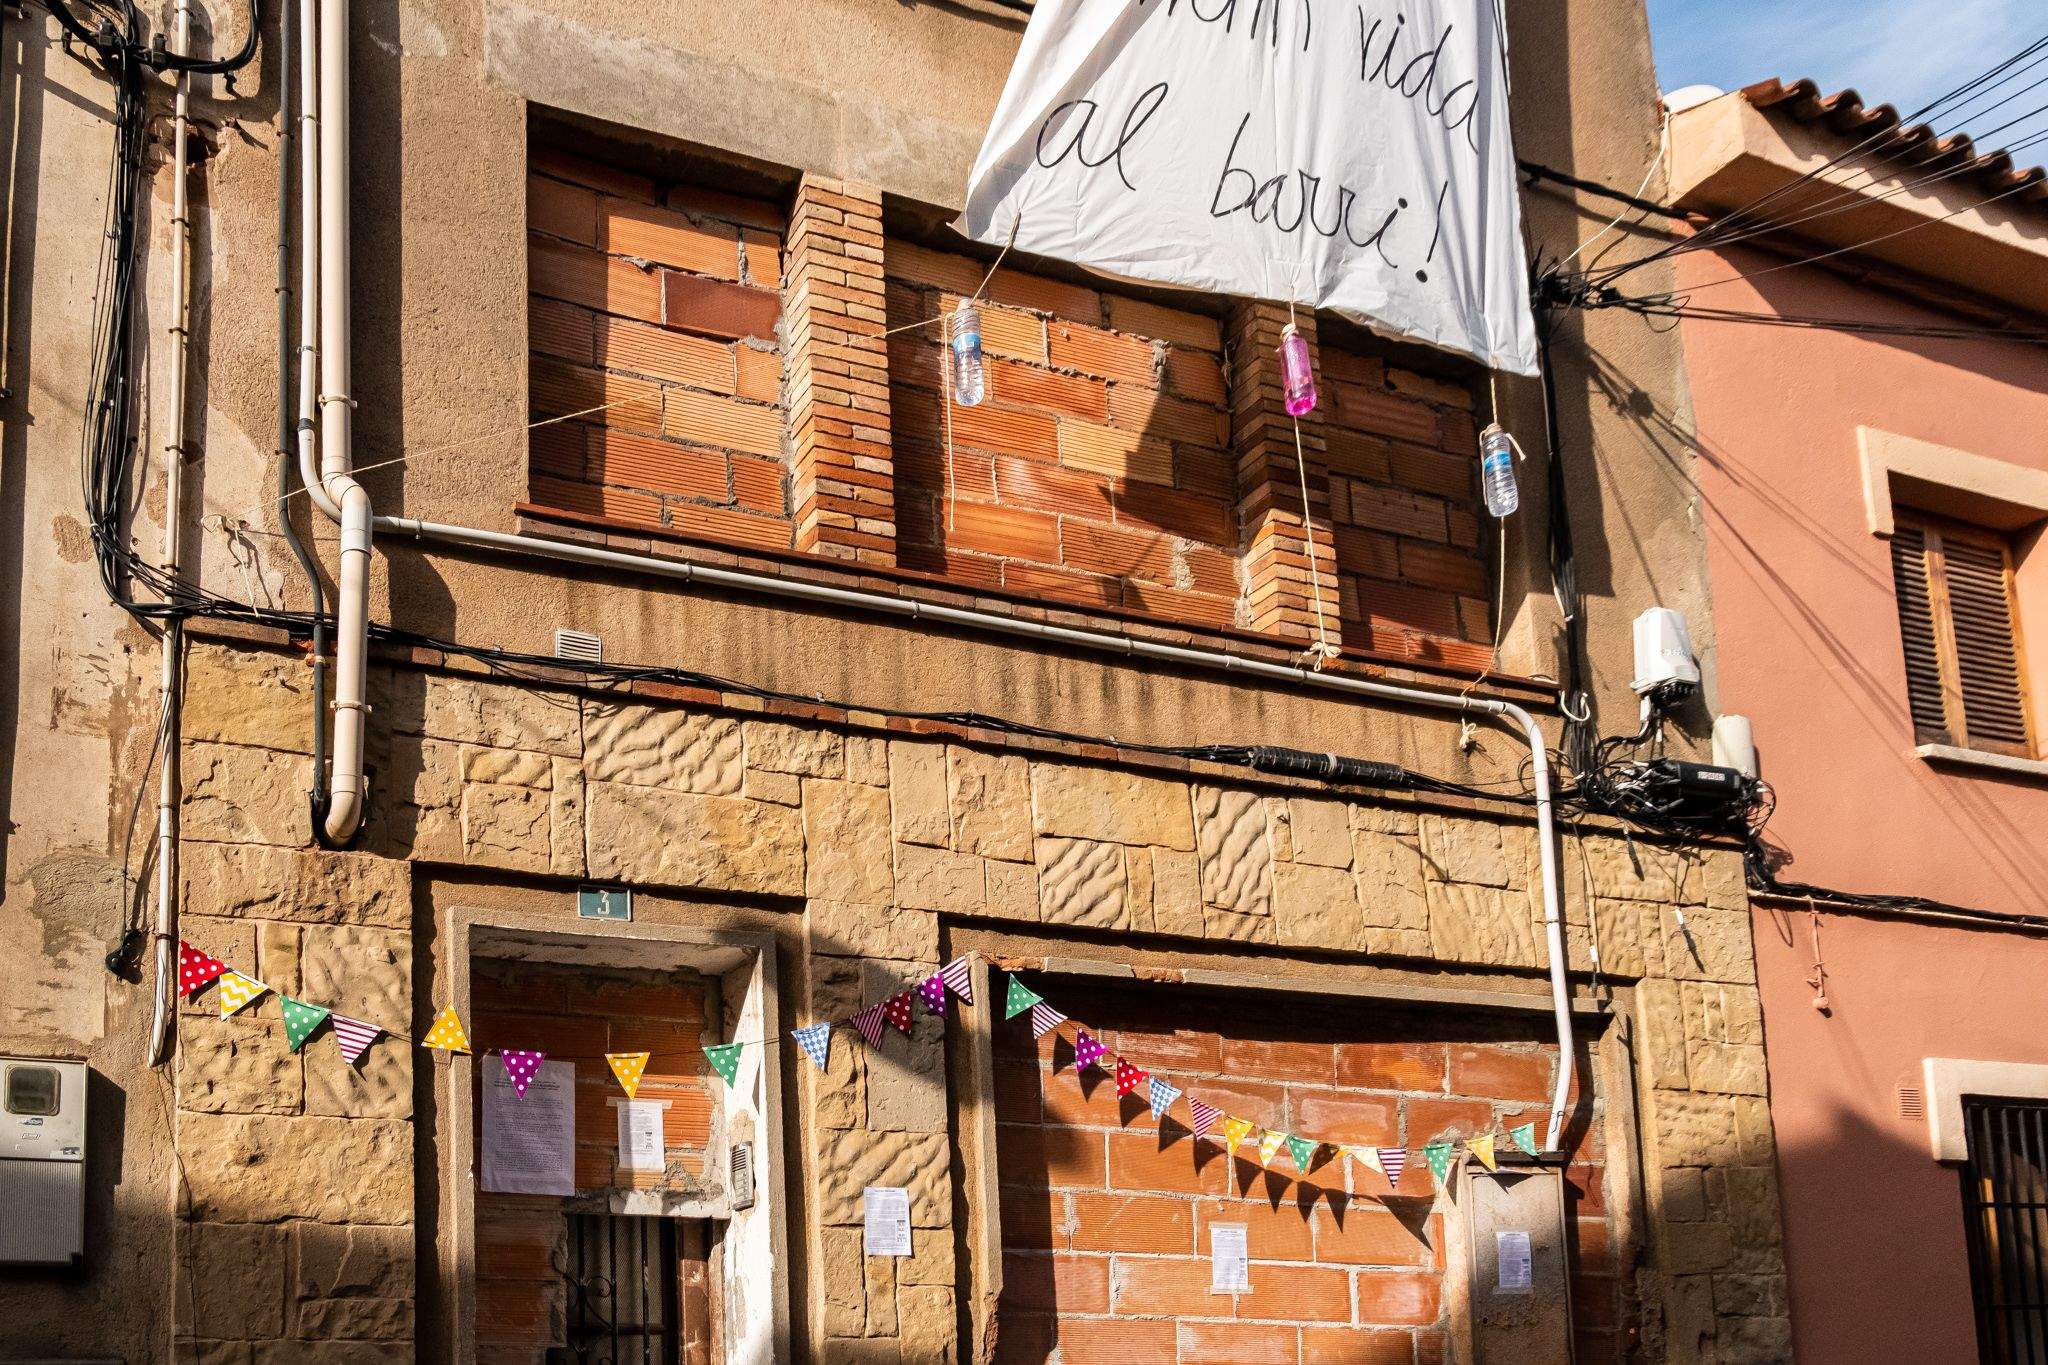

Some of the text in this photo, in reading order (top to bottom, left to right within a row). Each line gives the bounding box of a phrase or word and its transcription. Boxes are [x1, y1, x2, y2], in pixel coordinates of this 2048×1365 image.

[1035, 82, 1449, 284] al barri!
[597, 889, 610, 915] 3
